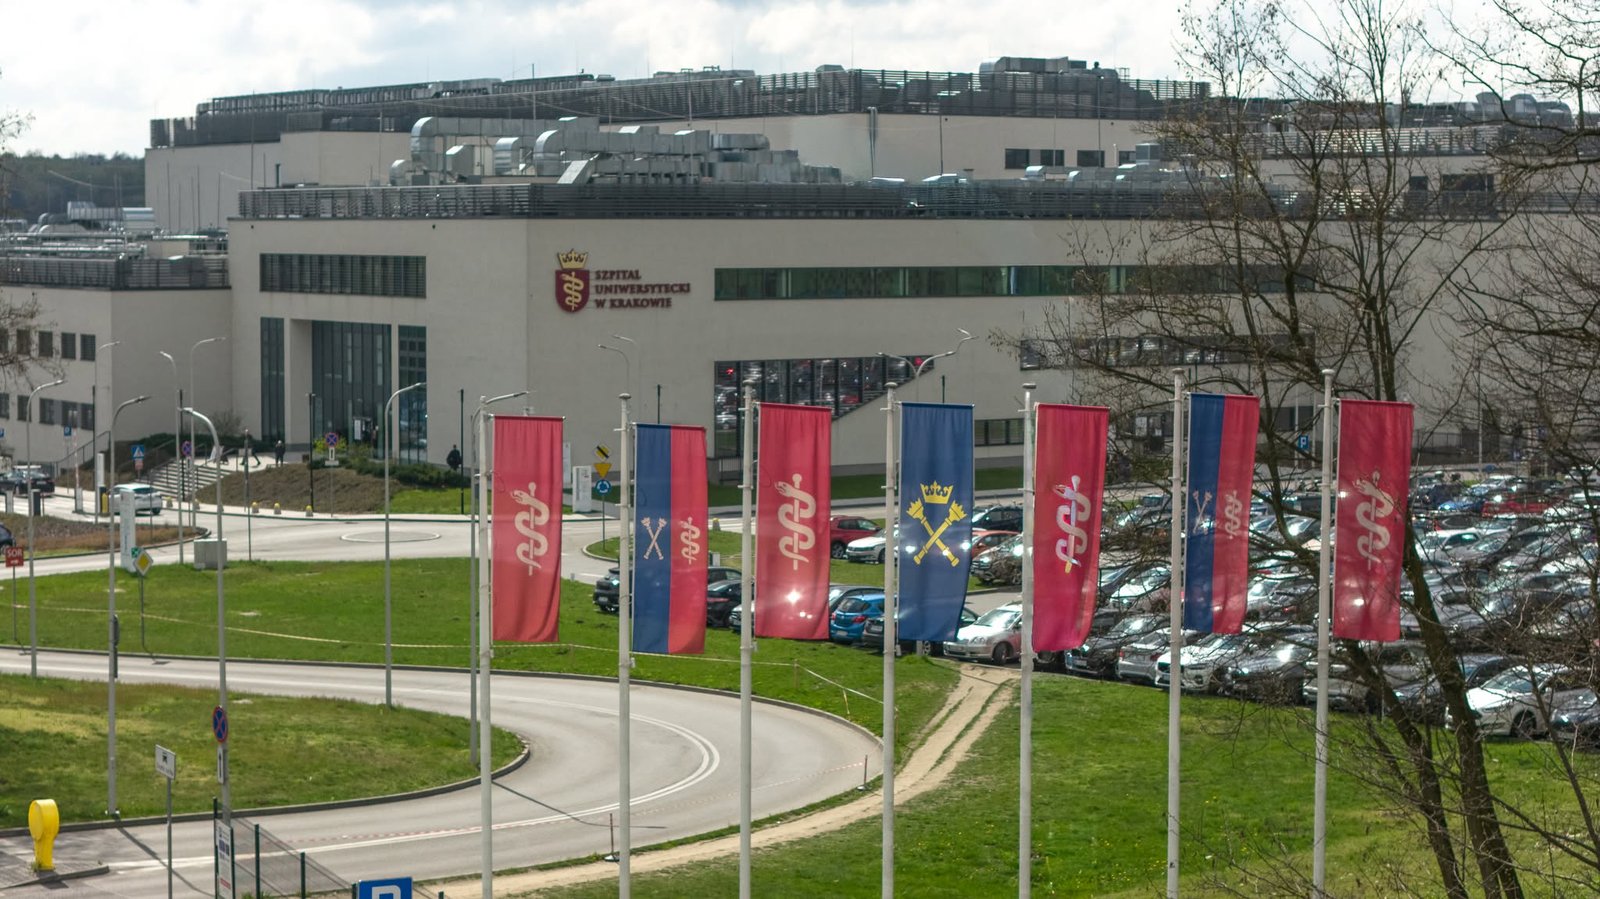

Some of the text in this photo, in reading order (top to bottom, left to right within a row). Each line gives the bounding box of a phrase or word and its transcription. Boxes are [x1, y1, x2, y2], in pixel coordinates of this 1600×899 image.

[595, 269, 641, 281] SZPITAL
[594, 283, 691, 295] UNIWERSYTECKI
[595, 297, 672, 309] W KRAKOWIE
[1300, 437, 1306, 448] P
[7, 548, 22, 557] SOR
